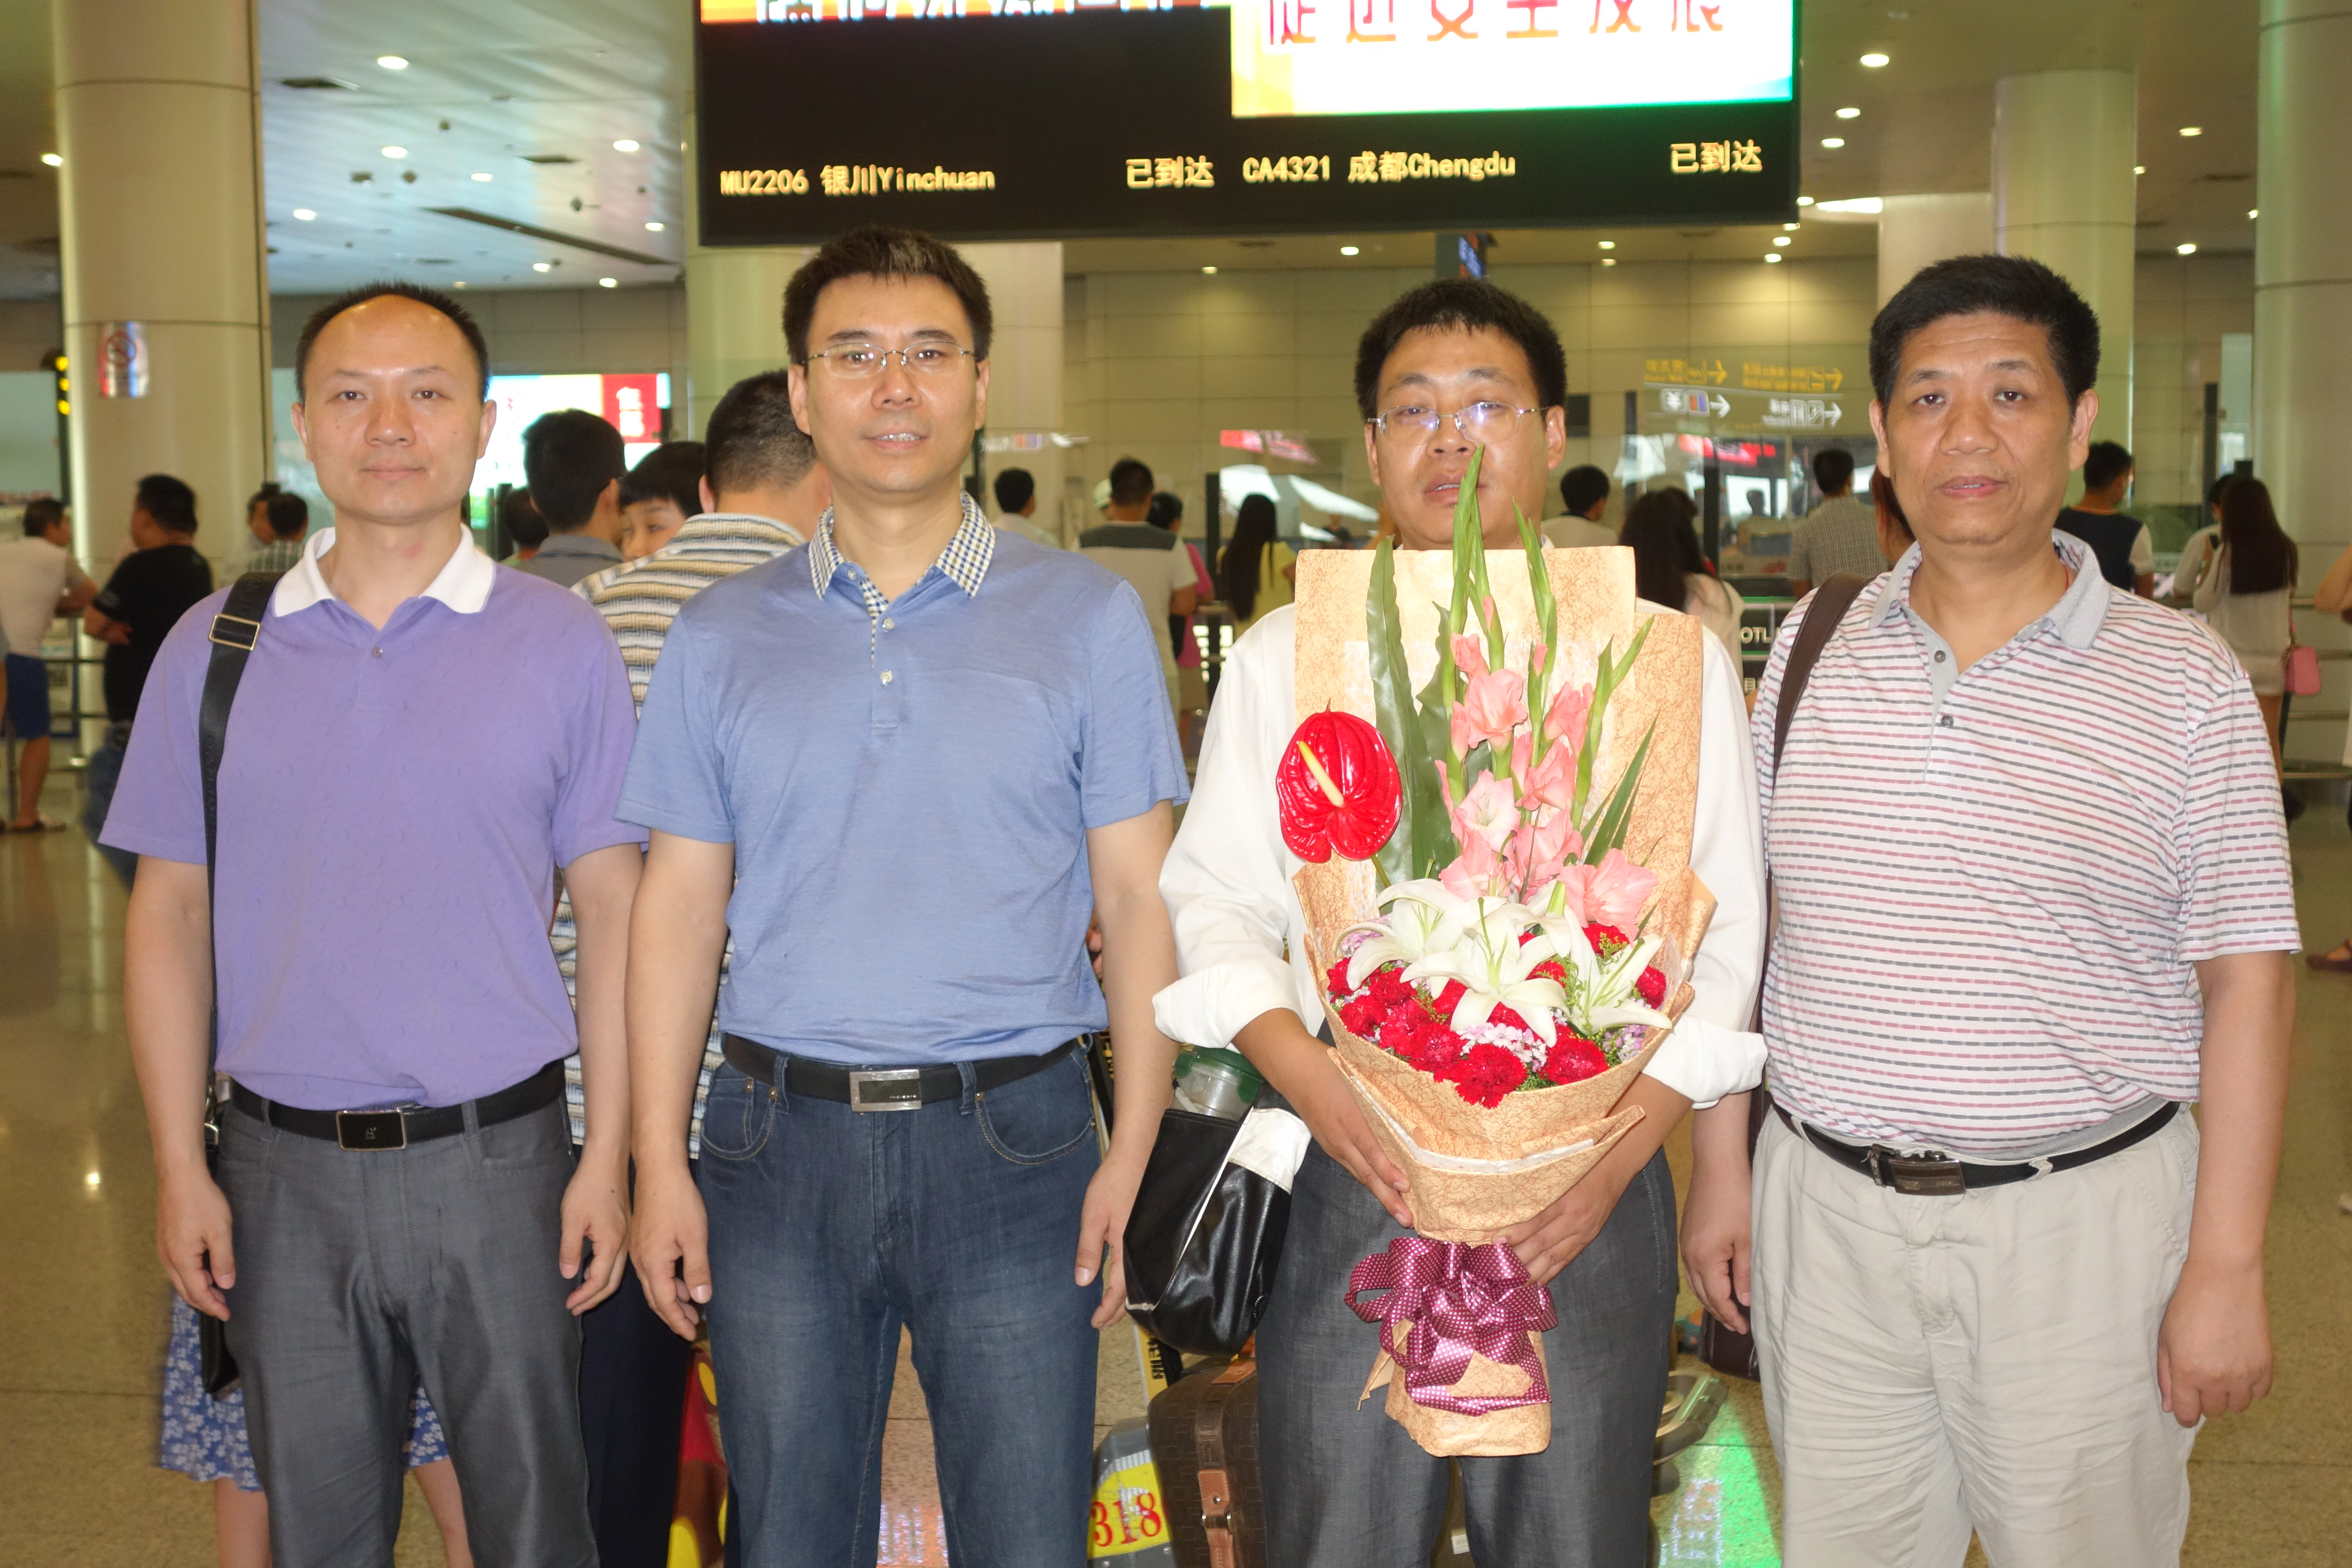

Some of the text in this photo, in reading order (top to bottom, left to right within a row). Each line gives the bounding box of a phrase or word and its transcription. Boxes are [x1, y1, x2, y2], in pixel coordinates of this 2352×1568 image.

[720, 169, 809, 195] MU2206
[1126, 155, 1214, 189] 已到达
[1243, 155, 1330, 183] CA4321
[1671, 139, 1763, 174] 已到达
[1741, 627, 1779, 644] OTL
[1090, 1492, 1162, 1547] 318
